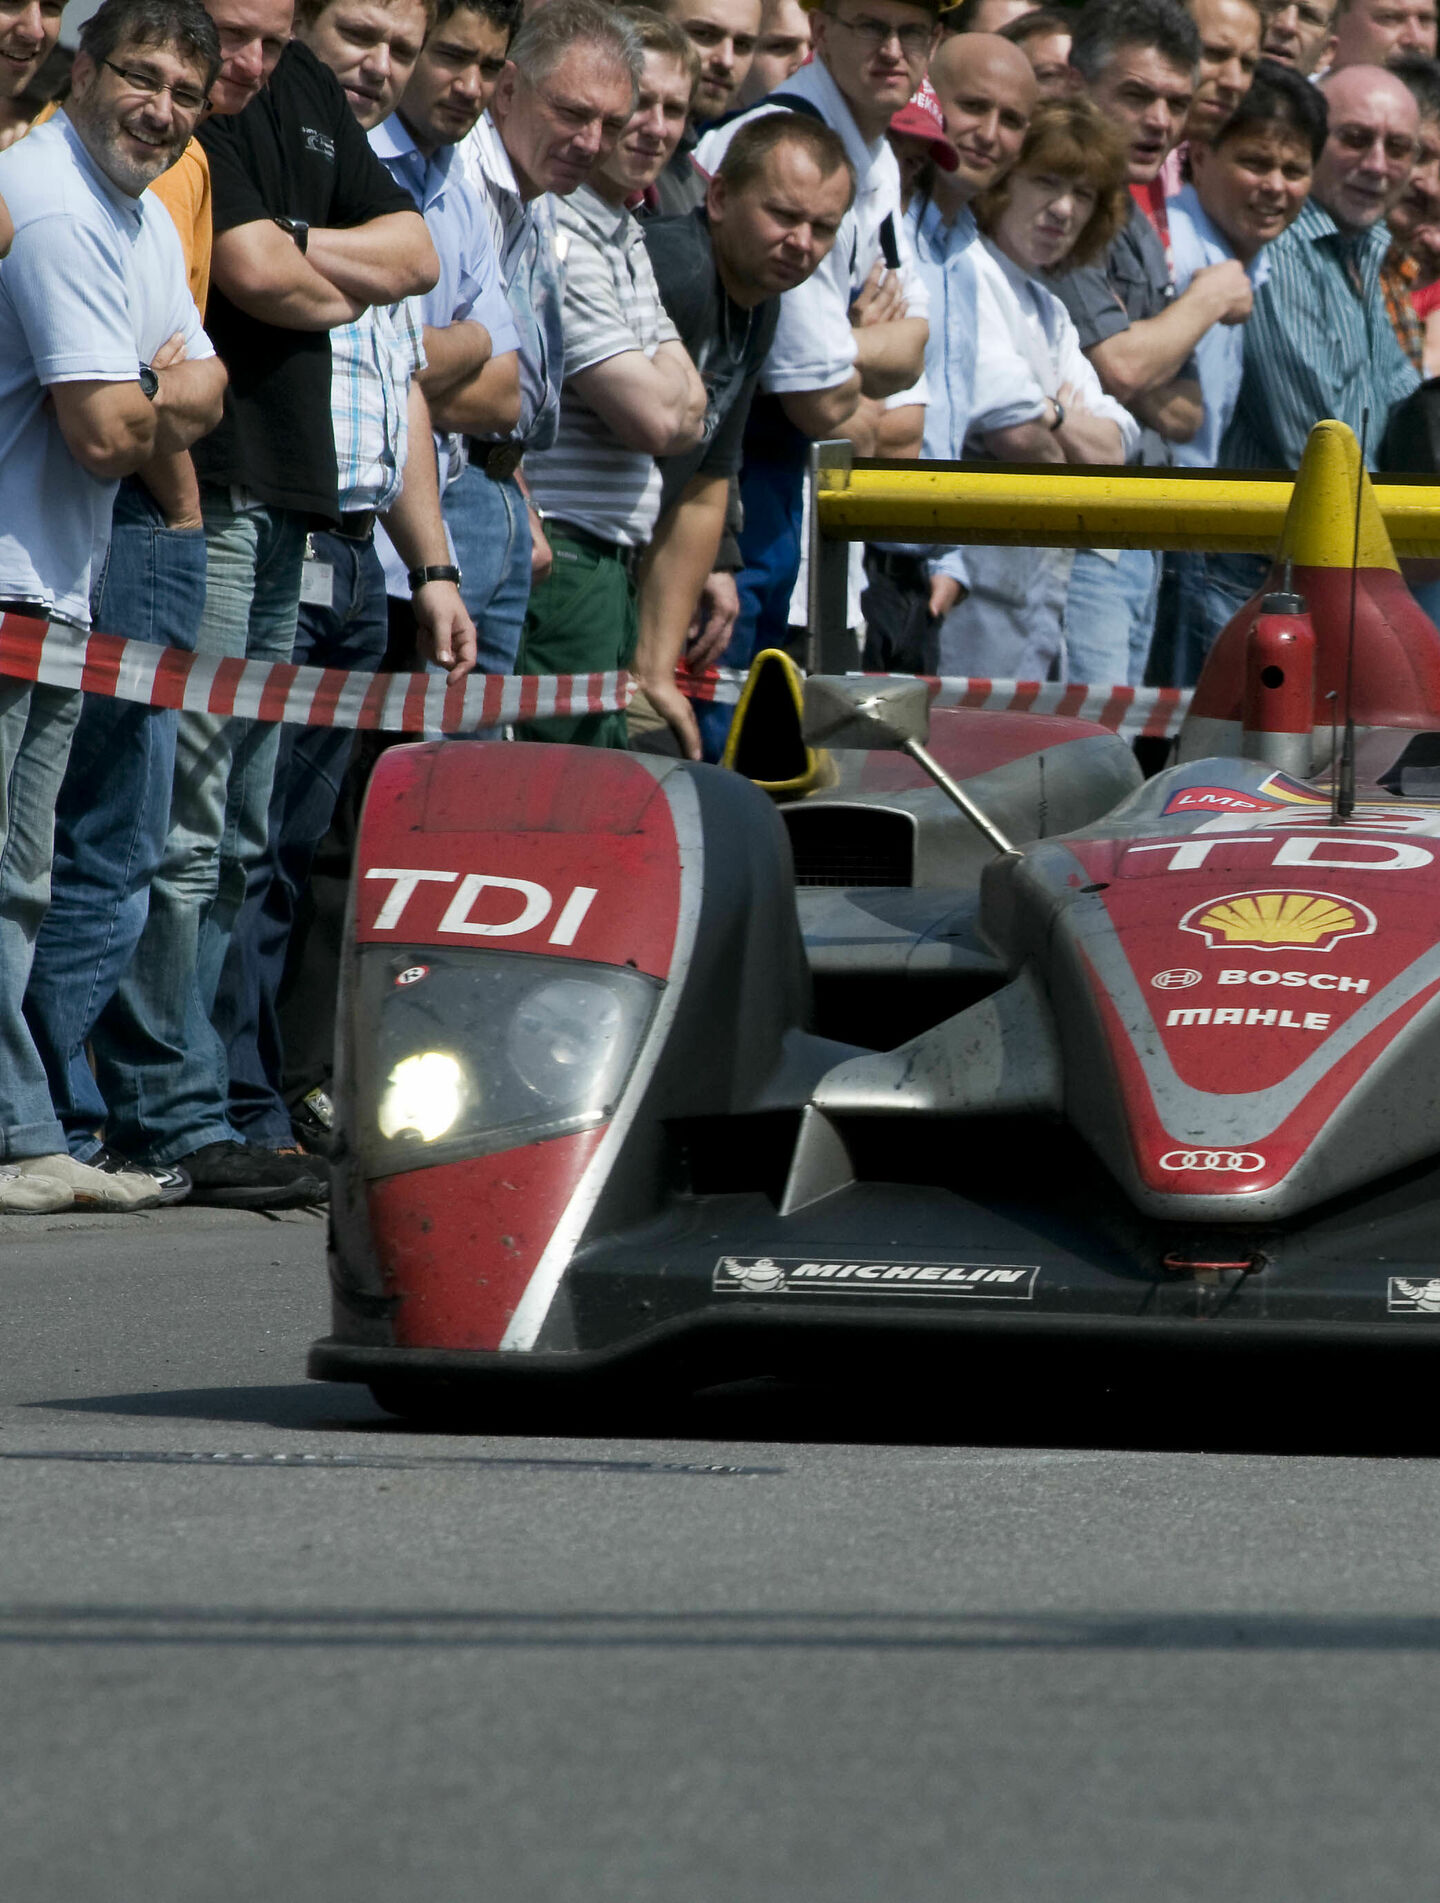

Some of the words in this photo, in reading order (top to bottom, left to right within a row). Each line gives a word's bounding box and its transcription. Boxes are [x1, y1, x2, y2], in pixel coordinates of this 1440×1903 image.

[1178, 794, 1272, 813] LMP1
[364, 868, 598, 946] TDI
[1217, 969, 1370, 994] BOSCH
[1166, 1008, 1331, 1031] MAHLE
[790, 1263, 1028, 1284] MICHELIN
